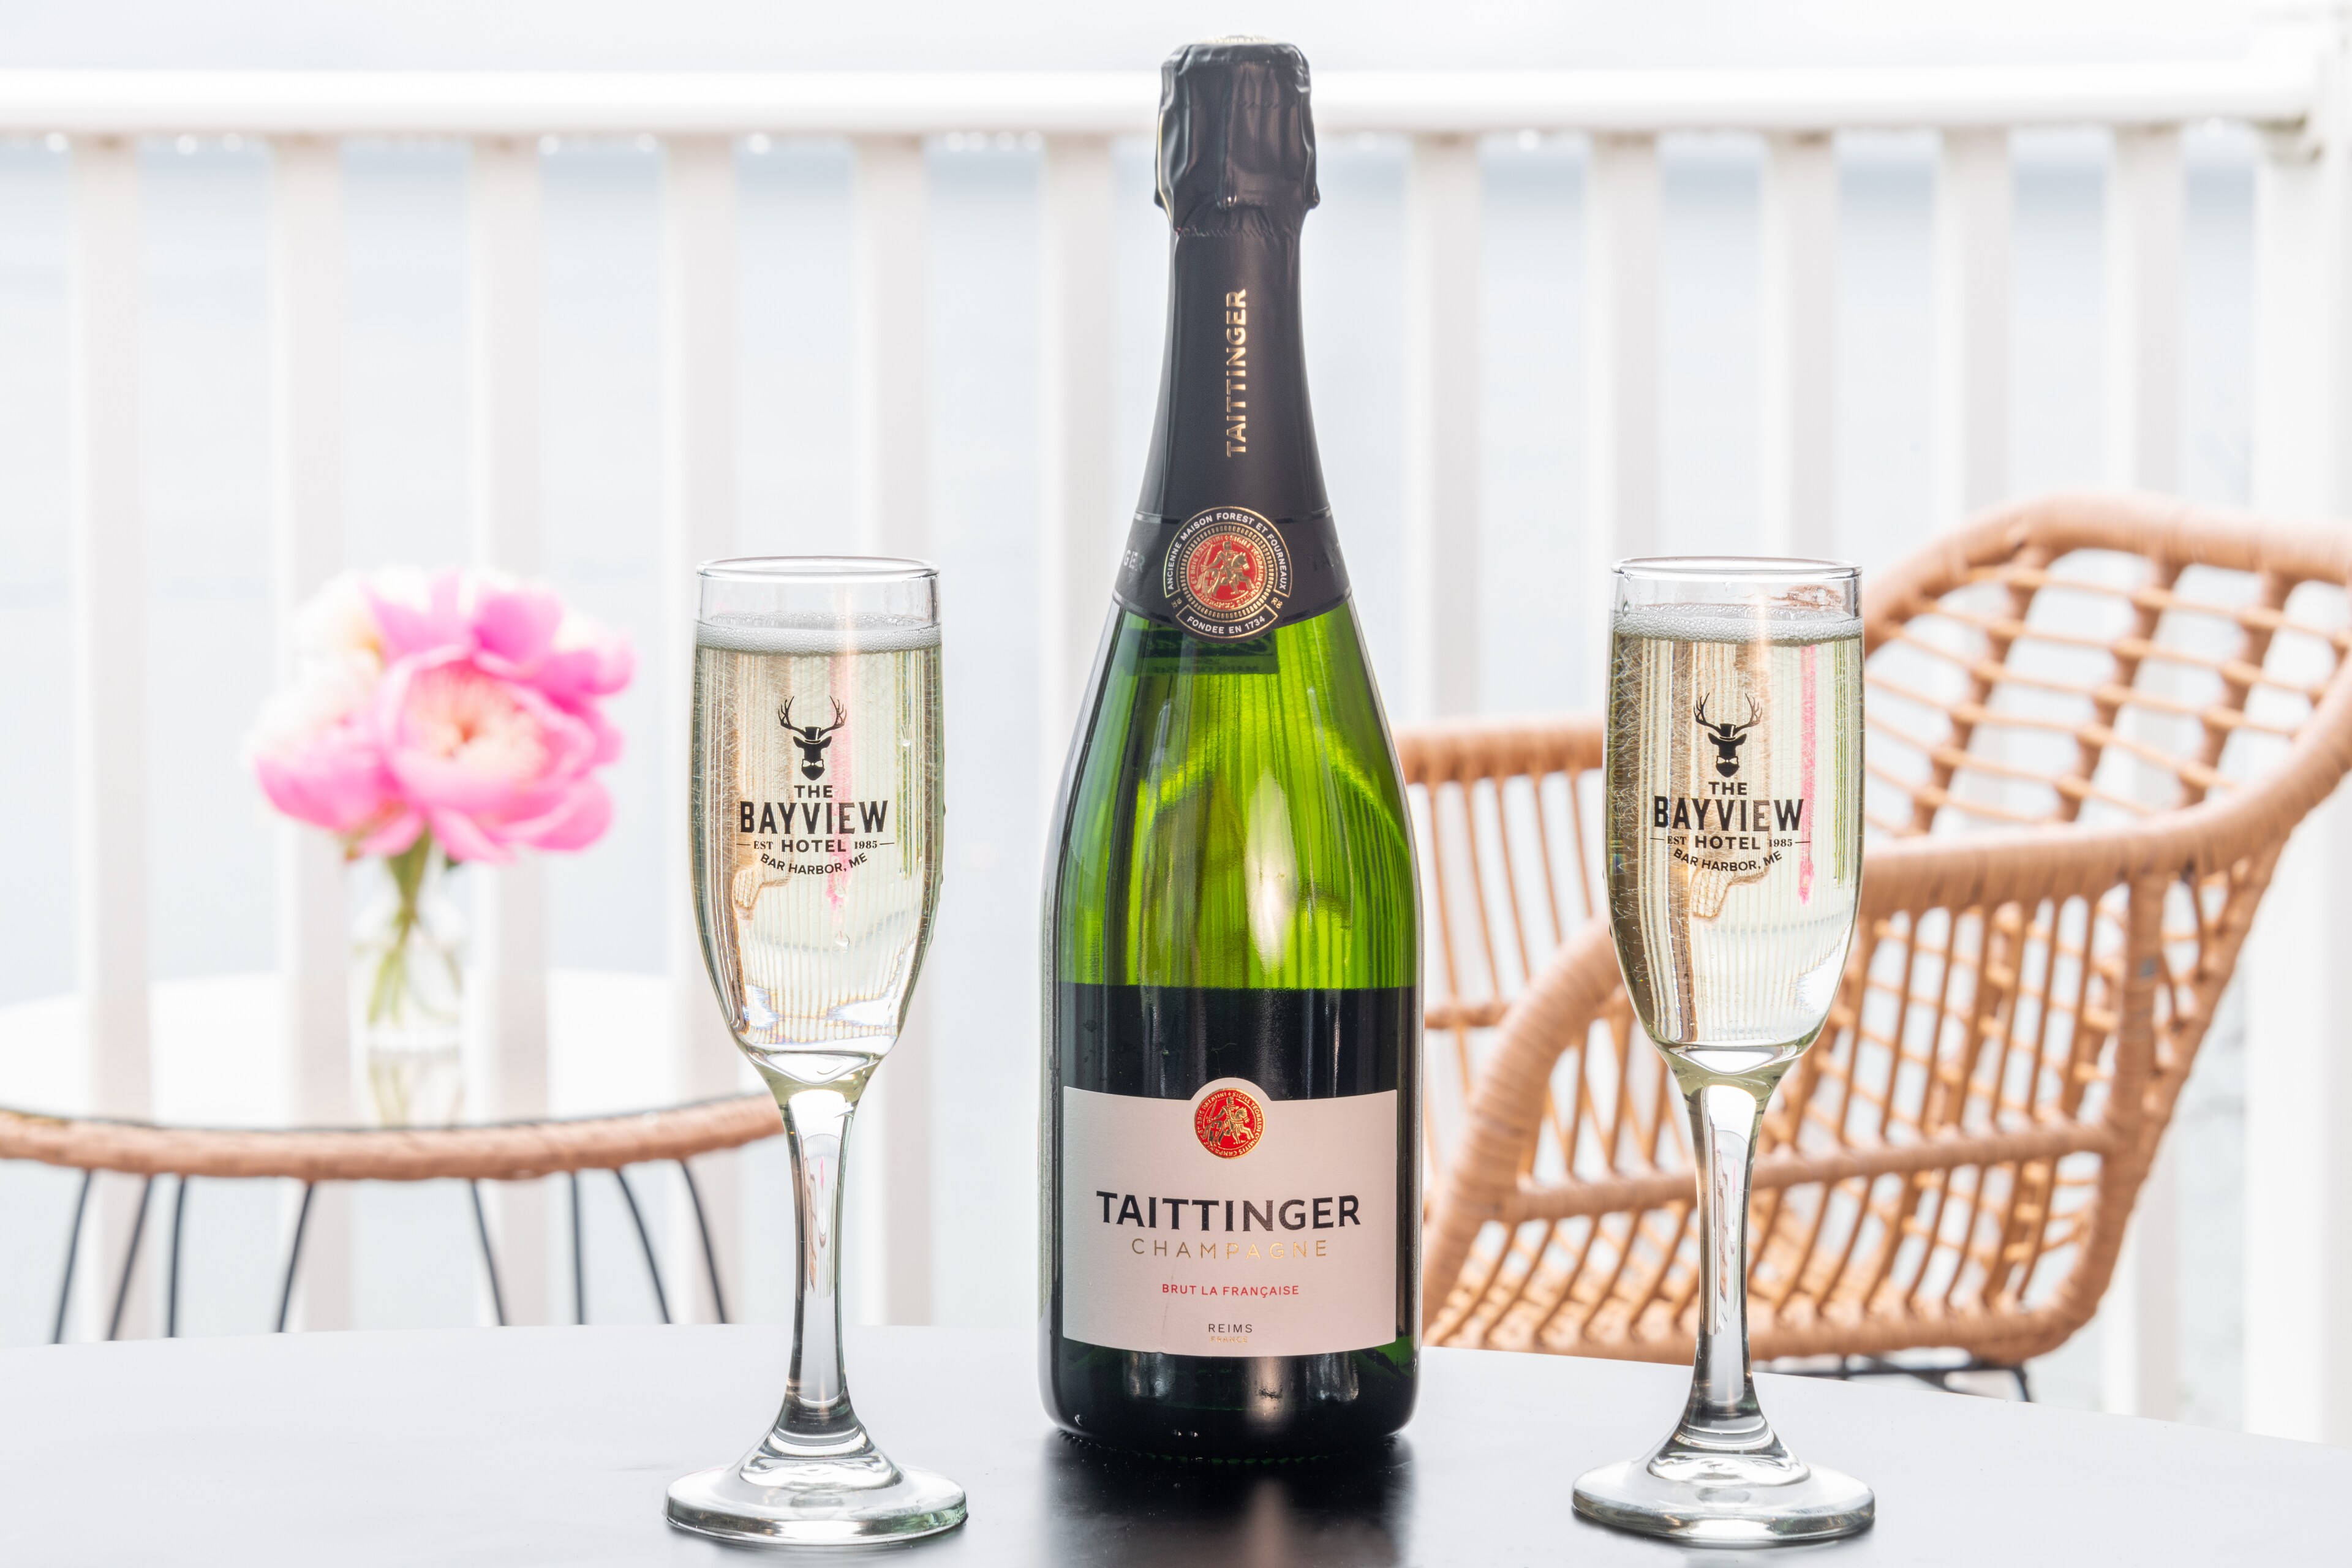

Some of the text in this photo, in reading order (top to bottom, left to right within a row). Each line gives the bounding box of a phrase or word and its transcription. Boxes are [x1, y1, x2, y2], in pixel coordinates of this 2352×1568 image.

[1226, 288, 1246, 458] TAITTINGER
[1167, 513, 1287, 590] ANCIENNE MAISON FOREST ET FOURNEAUX
[1271, 597, 1278, 605] 20
[1186, 615, 1265, 634] FONDEE EN 1734
[794, 785, 833, 798] THE
[1708, 782, 1747, 795] THE
[740, 800, 888, 834] BAYVIEW
[1654, 795, 1804, 832] BAYVIEW
[753, 839, 878, 853] EST HOTEL 1985
[1667, 835, 1793, 850] EST HOTEL 1985
[760, 852, 867, 875] BAR HARBOR, ME
[1673, 848, 1782, 872] BAR HARBOR, ME
[1232, 1092, 1251, 1104] SIGILL
[1250, 1102, 1262, 1133] TEOBALDI
[1096, 1190, 1361, 1232] TAITTINGER
[1131, 1237, 1327, 1260] CHAMPAGNE
[1162, 1284, 1299, 1298] BRUT LA FRANÇAISE
[1208, 1324, 1253, 1333] REIMS
